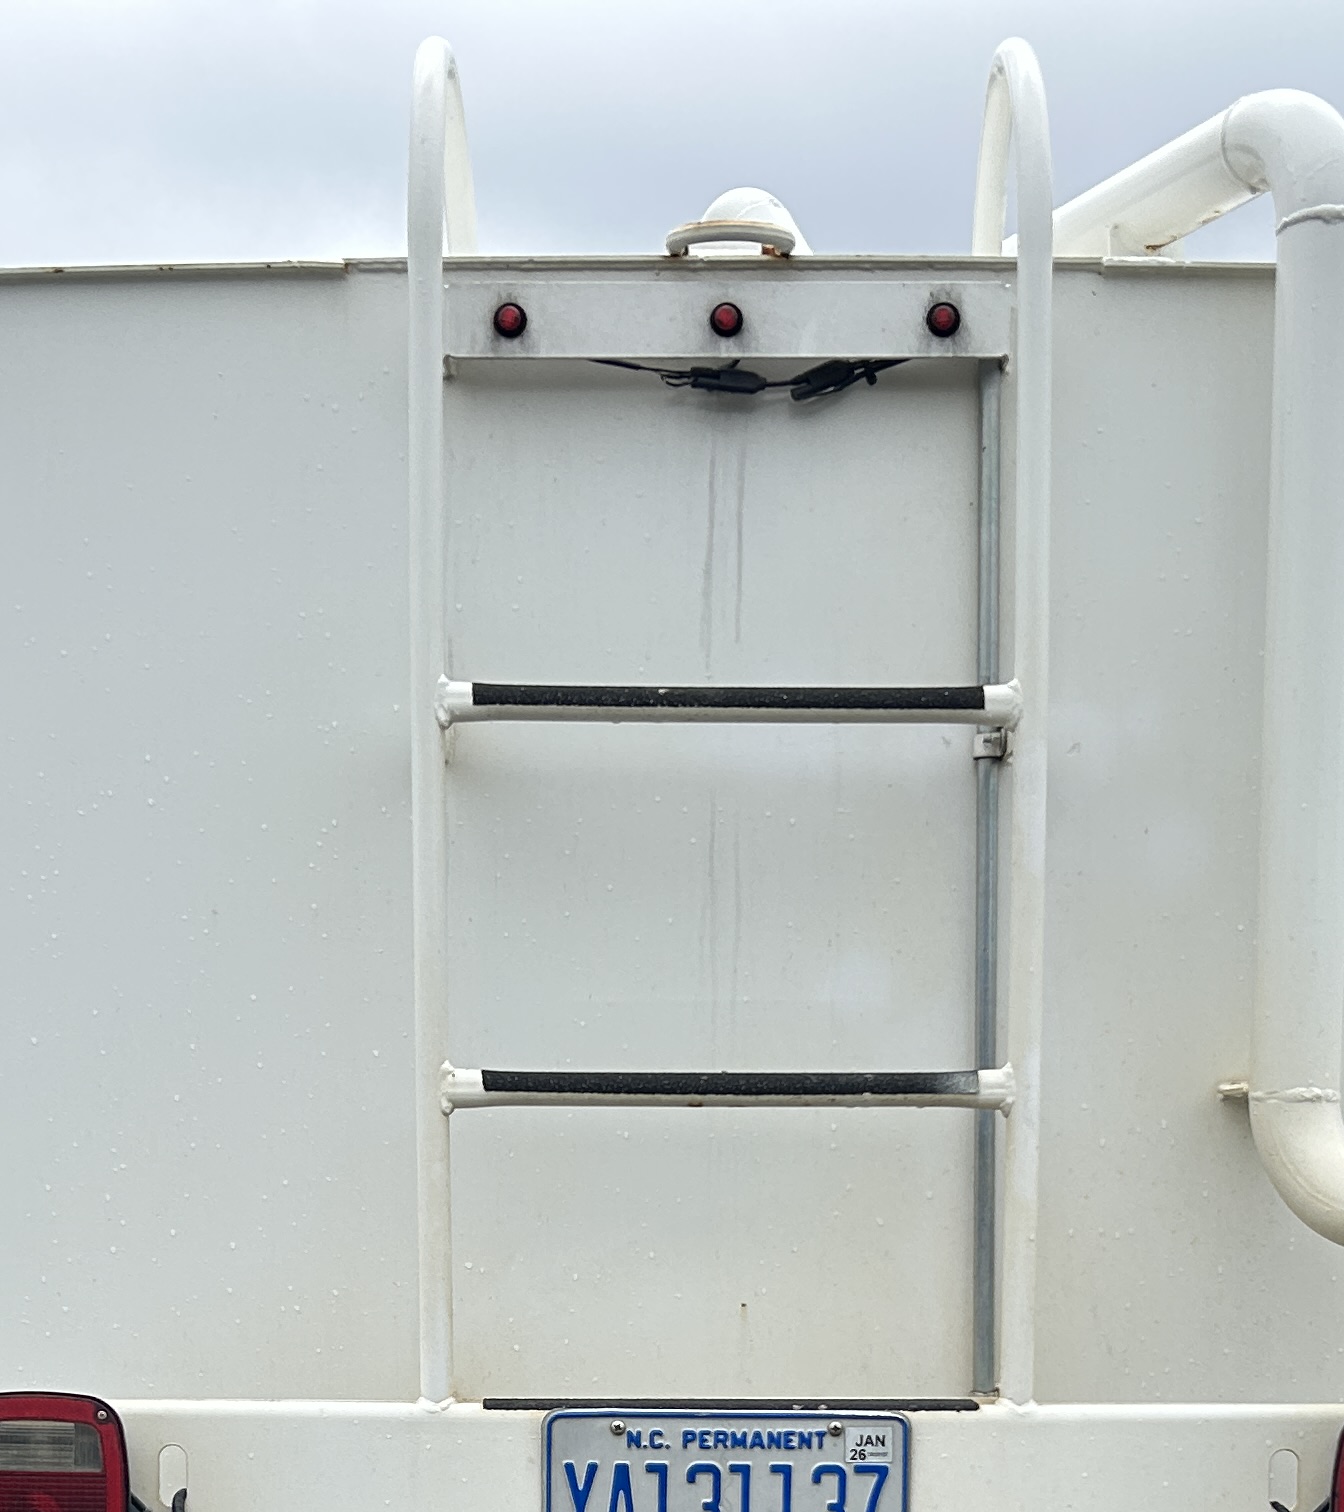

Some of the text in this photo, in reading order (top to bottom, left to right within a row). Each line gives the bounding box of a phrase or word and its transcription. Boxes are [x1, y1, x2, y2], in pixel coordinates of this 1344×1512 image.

[625, 1428, 828, 1450] N.C. PERMANENT
[855, 1434, 886, 1447] JAN
[849, 1448, 867, 1461] 26
